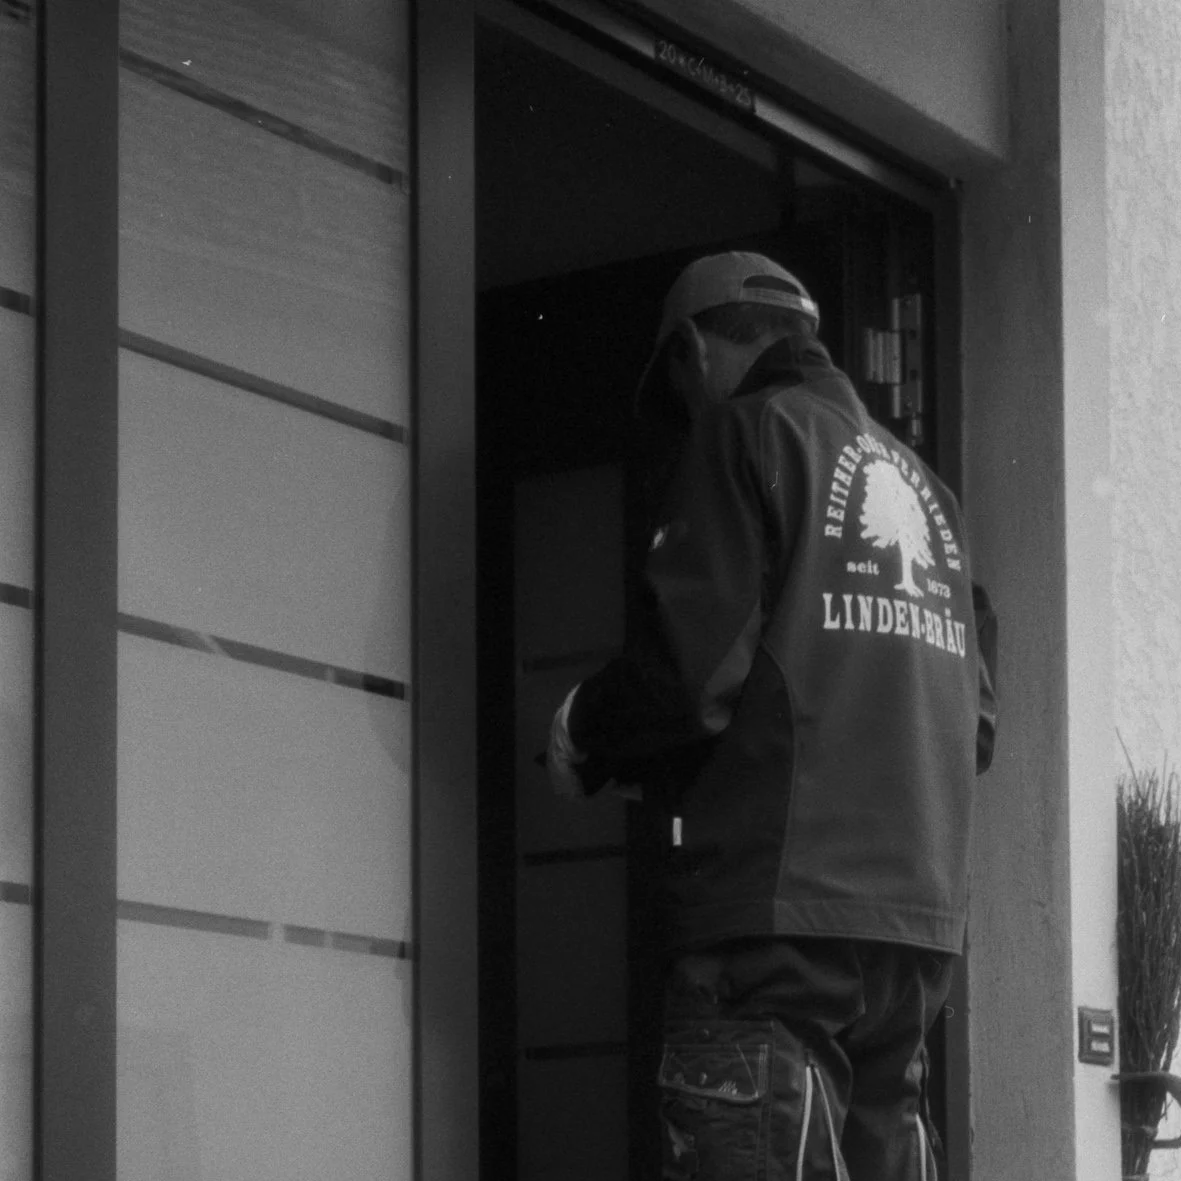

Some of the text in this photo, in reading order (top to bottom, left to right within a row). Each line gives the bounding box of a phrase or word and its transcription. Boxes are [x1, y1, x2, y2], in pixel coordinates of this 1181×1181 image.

[846, 560, 951, 599] seit 1873
[822, 592, 966, 659] LINDEN-BRÄU
